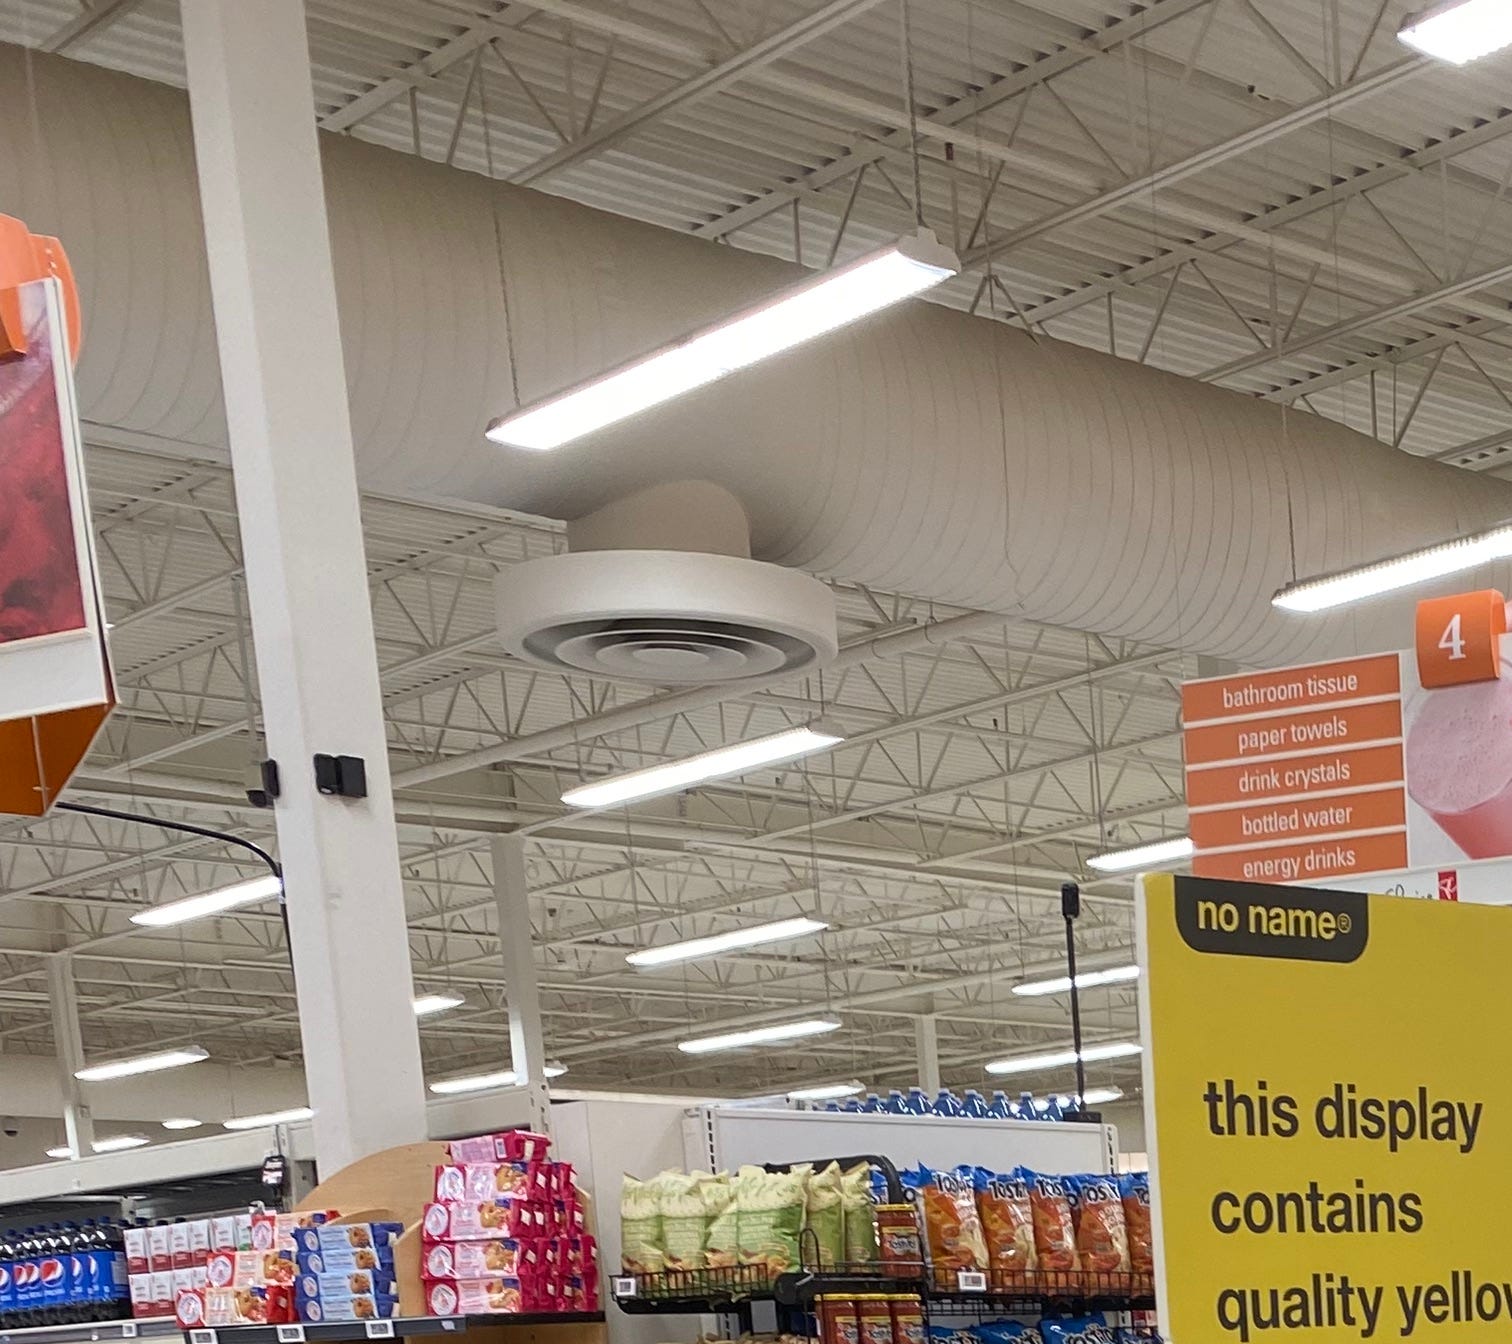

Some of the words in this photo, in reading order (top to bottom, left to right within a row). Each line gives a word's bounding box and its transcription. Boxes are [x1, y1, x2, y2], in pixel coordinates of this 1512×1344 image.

[1438, 613, 1466, 660] 4
[1222, 681, 1303, 709] bathroom
[1306, 671, 1358, 697] tissue
[1237, 725, 1287, 754] paper
[1290, 716, 1348, 742] towels
[1238, 766, 1281, 793] drink
[1284, 760, 1350, 789] crystals
[1241, 807, 1300, 836] bottled
[1302, 806, 1353, 831] water
[1242, 854, 1300, 882] energy
[1303, 846, 1356, 873] drinks
[1197, 897, 1240, 935] no
[1203, 1079, 1299, 1138] this
[1315, 1083, 1483, 1154] display
[1211, 1179, 1423, 1235] contains
[1216, 1273, 1381, 1343] quality
